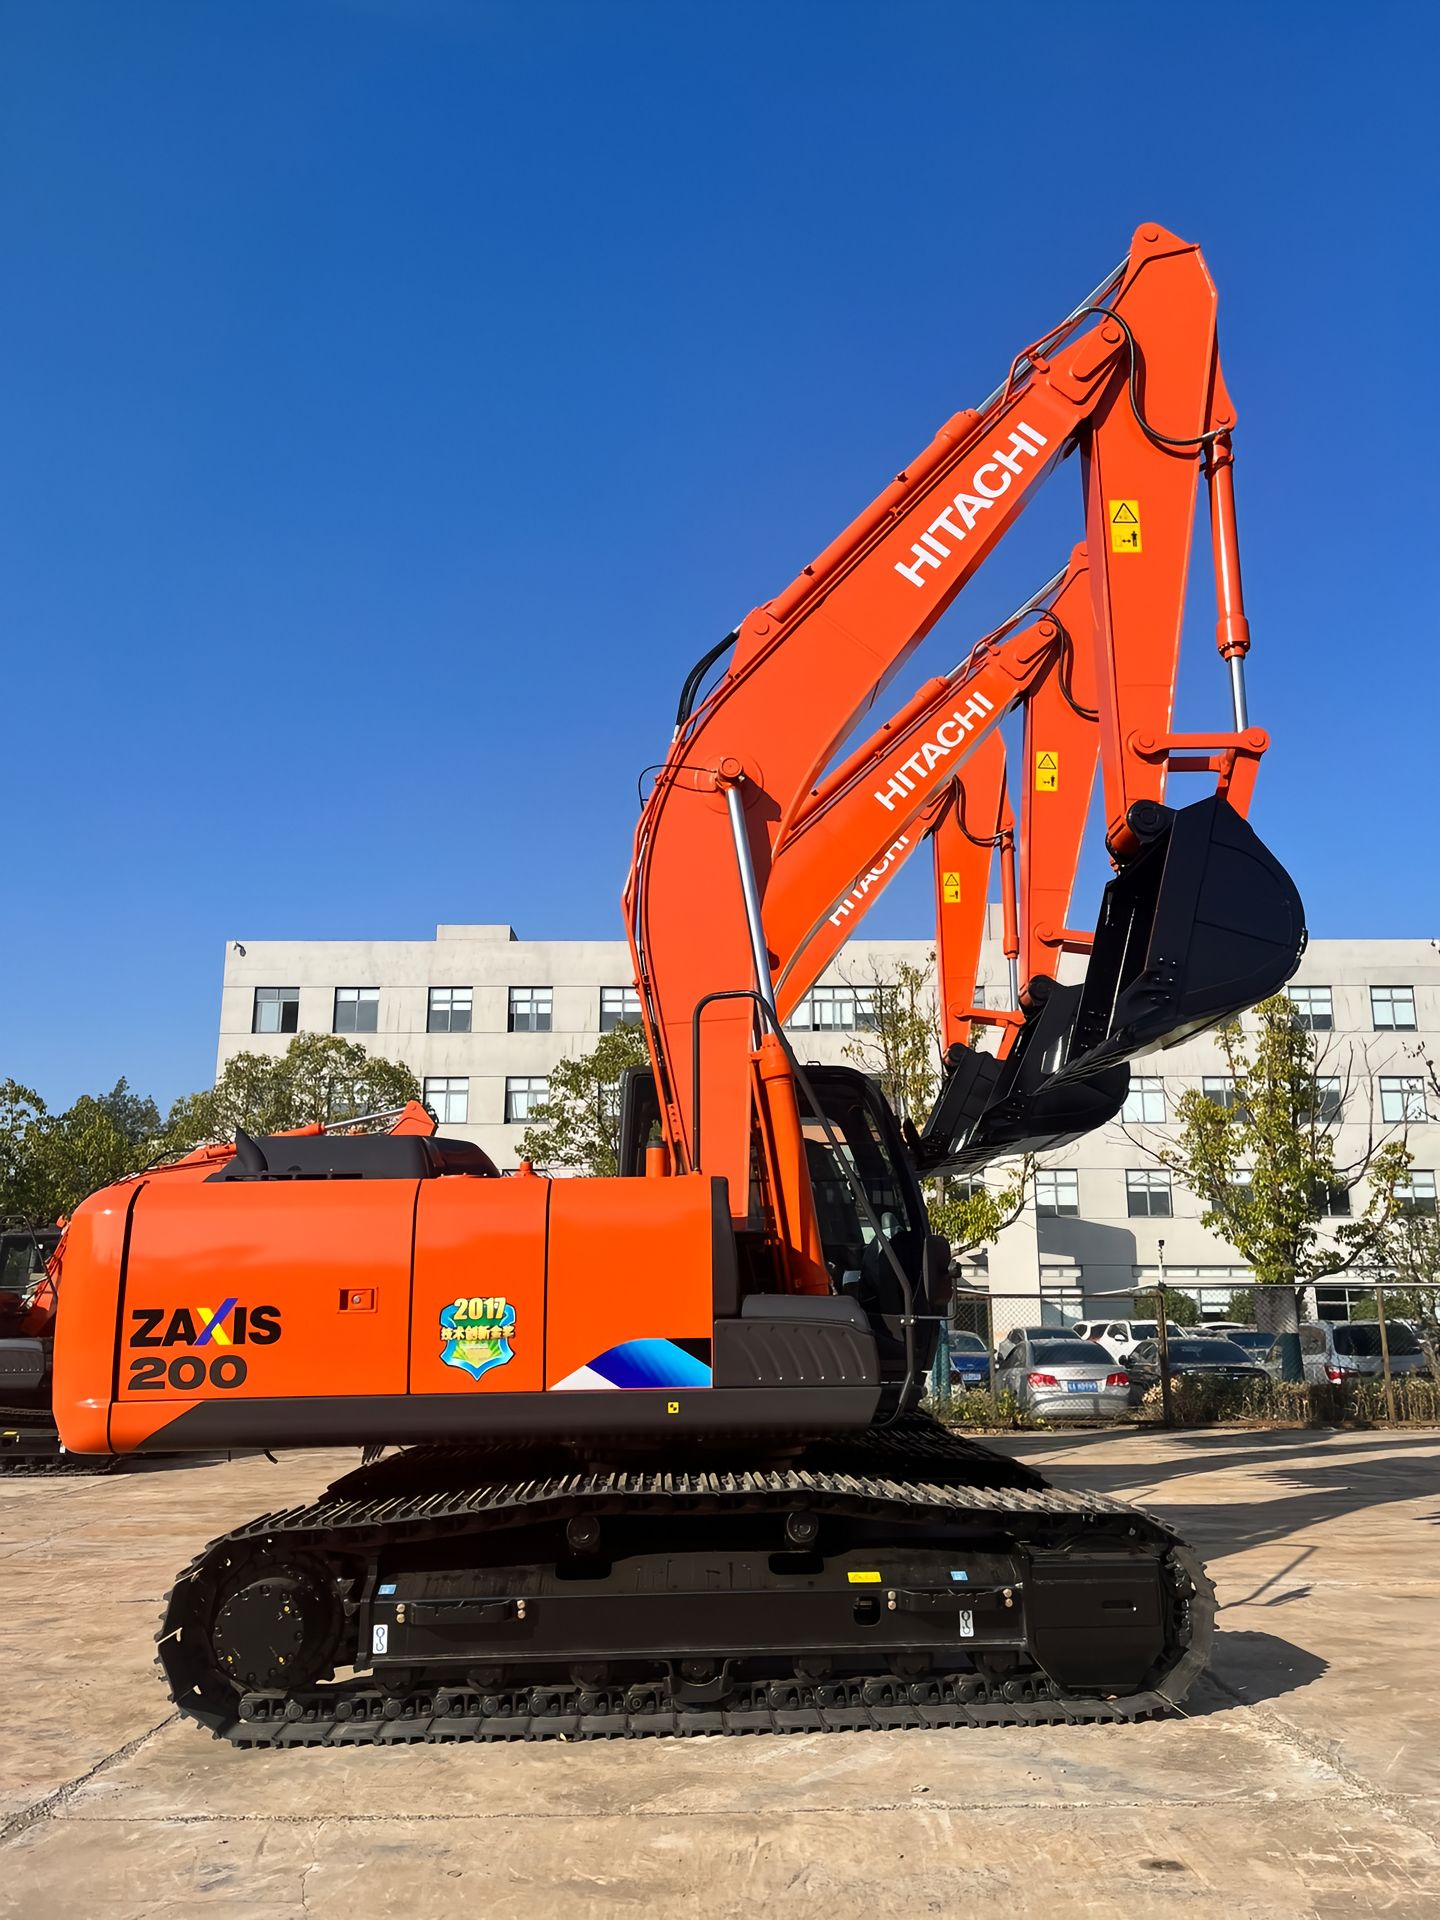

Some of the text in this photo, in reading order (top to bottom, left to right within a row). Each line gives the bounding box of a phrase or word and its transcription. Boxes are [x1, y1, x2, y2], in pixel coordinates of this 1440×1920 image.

[894, 421, 1047, 588] HITACHI
[874, 691, 994, 811] HITACHI
[130, 1298, 282, 1348] ZAXIS
[453, 1297, 506, 1320] 2017
[128, 1355, 247, 1390] 200
